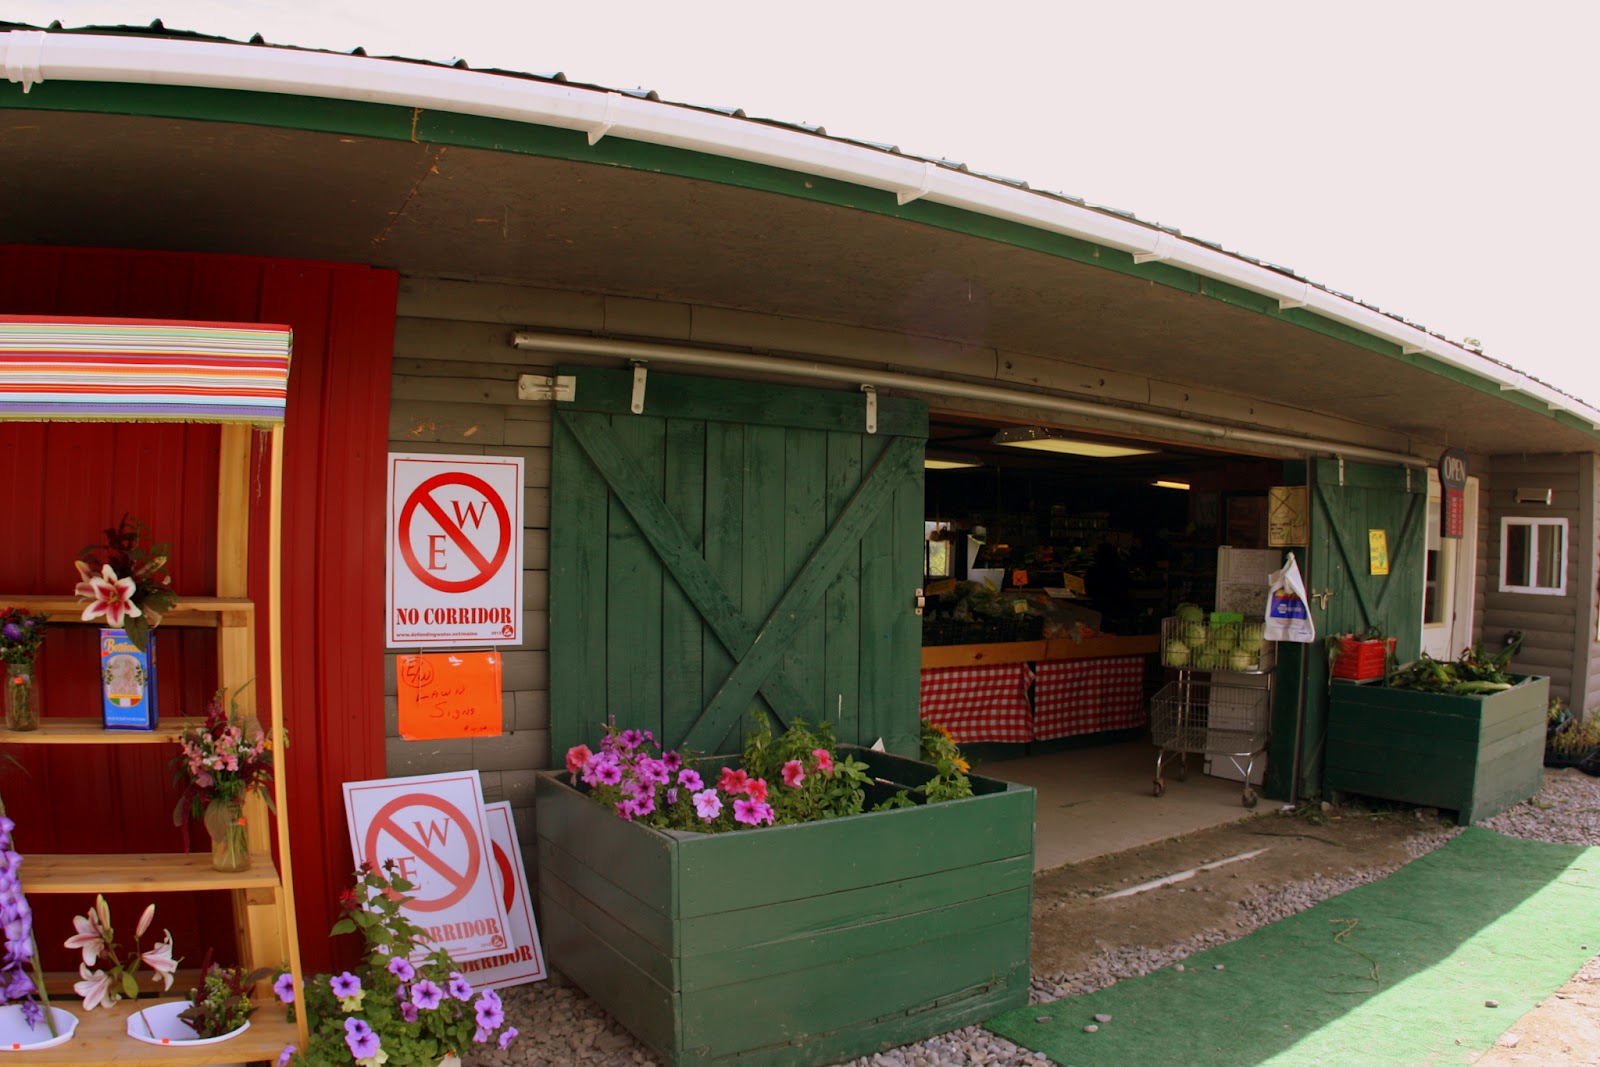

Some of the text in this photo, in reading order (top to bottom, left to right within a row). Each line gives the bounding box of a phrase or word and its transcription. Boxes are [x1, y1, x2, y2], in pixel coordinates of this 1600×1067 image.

[1444, 456, 1466, 481] OPEN
[451, 500, 488, 530] W
[427, 534, 447, 571] E
[396, 607, 512, 625] NO CORRIDOR
[412, 817, 450, 849] W
[397, 856, 422, 892] E
[408, 917, 500, 946] ORRIDOR
[457, 945, 533, 974] ORRIDOR
